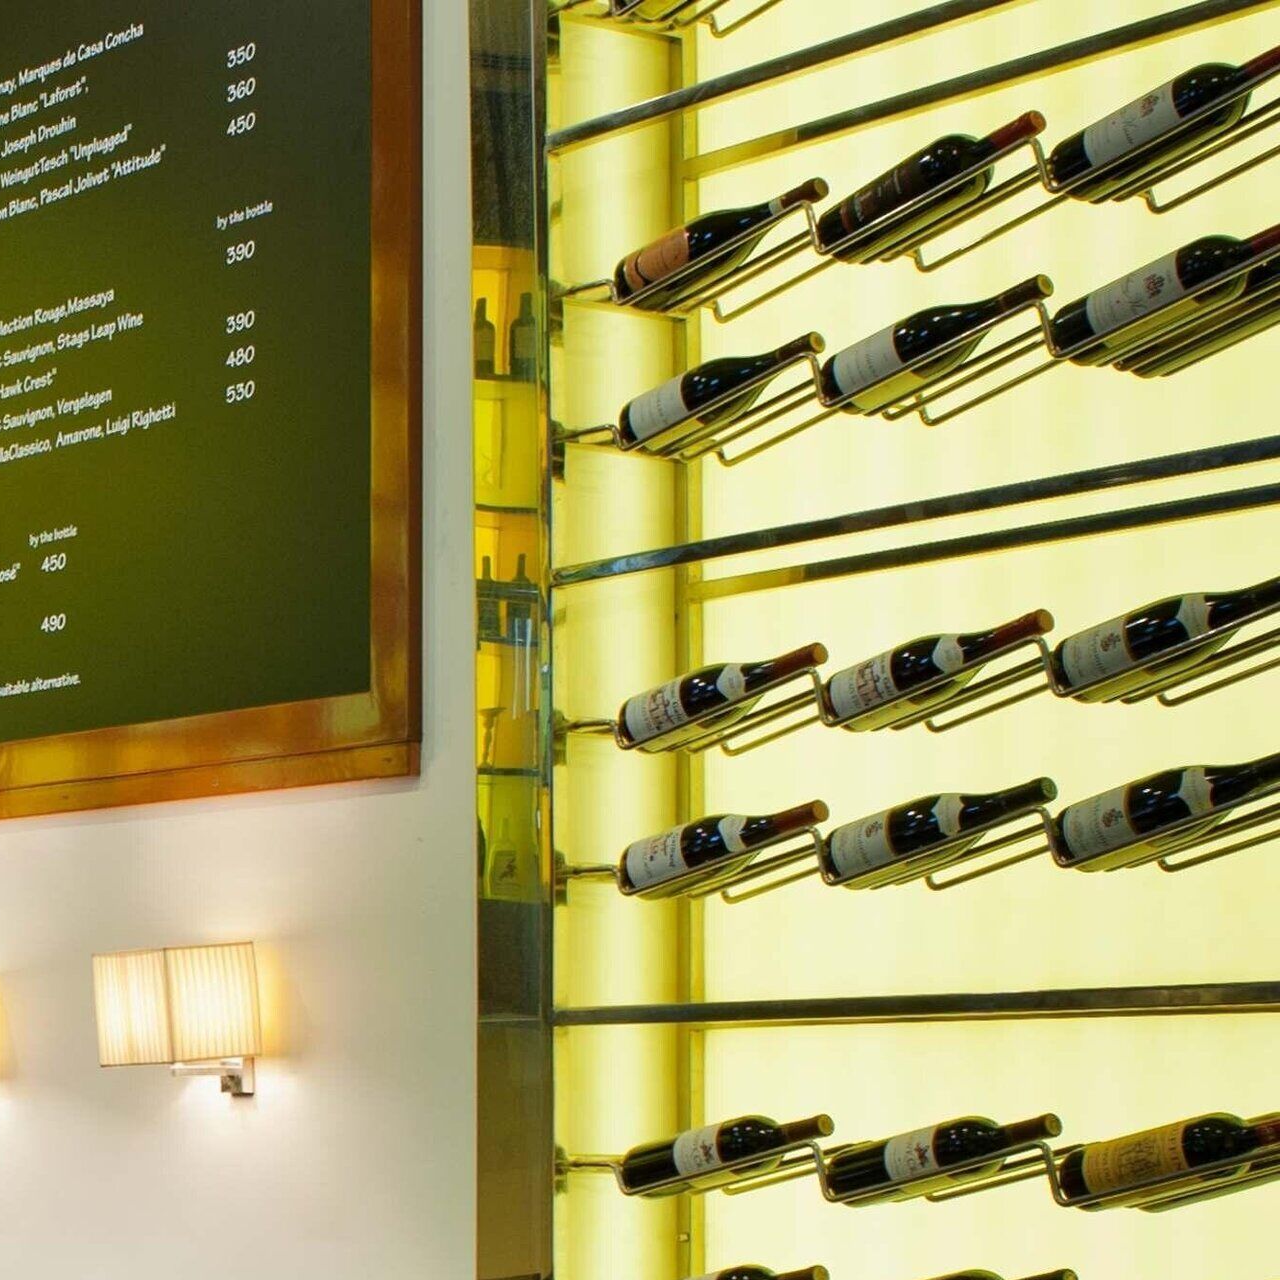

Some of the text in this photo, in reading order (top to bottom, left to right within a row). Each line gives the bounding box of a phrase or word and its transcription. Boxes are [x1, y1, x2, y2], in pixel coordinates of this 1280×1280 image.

[226, 42, 256, 69] 350
[227, 77, 256, 103] 360
[226, 112, 256, 136] 450
[226, 240, 255, 265] 390
[117, 312, 144, 332] Wine
[226, 310, 255, 334] 390
[225, 345, 255, 368] 480
[226, 380, 255, 404] 530
[41, 552, 67, 573] 450
[40, 613, 67, 633] 490
